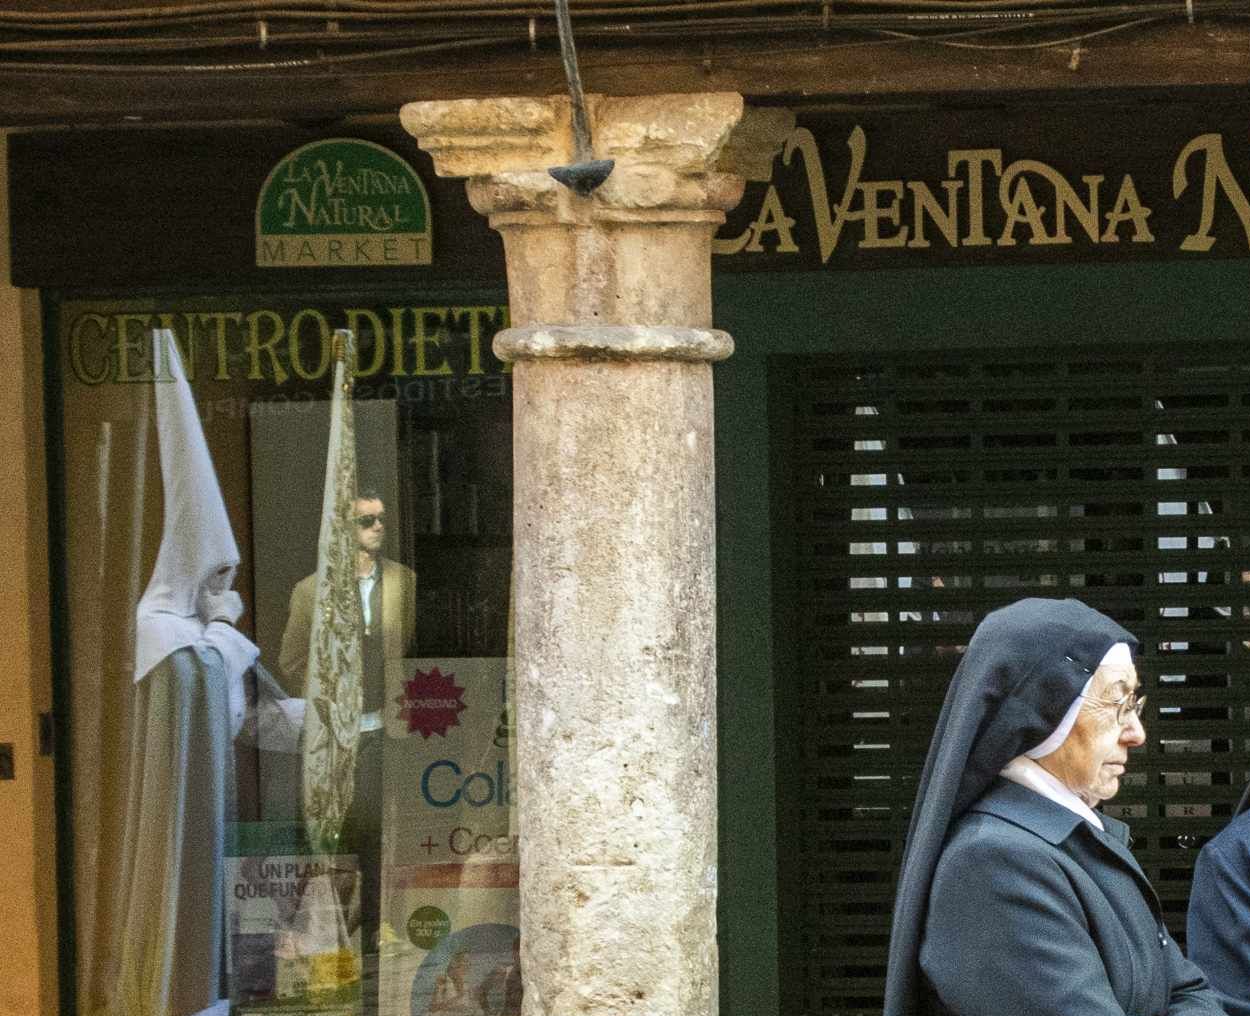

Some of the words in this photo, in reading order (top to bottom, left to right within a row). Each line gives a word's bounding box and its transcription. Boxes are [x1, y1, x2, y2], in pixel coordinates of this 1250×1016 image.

[281, 160, 313, 183] LA
[314, 159, 412, 197] VENTANA
[712, 184, 799, 254] A
[782, 125, 1155, 263] VENTANA
[277, 177, 409, 231] NATURAL
[262, 237, 427, 262] MARKET
[69, 308, 333, 386] CENTRO
[344, 304, 511, 378] DIET
[260, 863, 281, 879] UN
